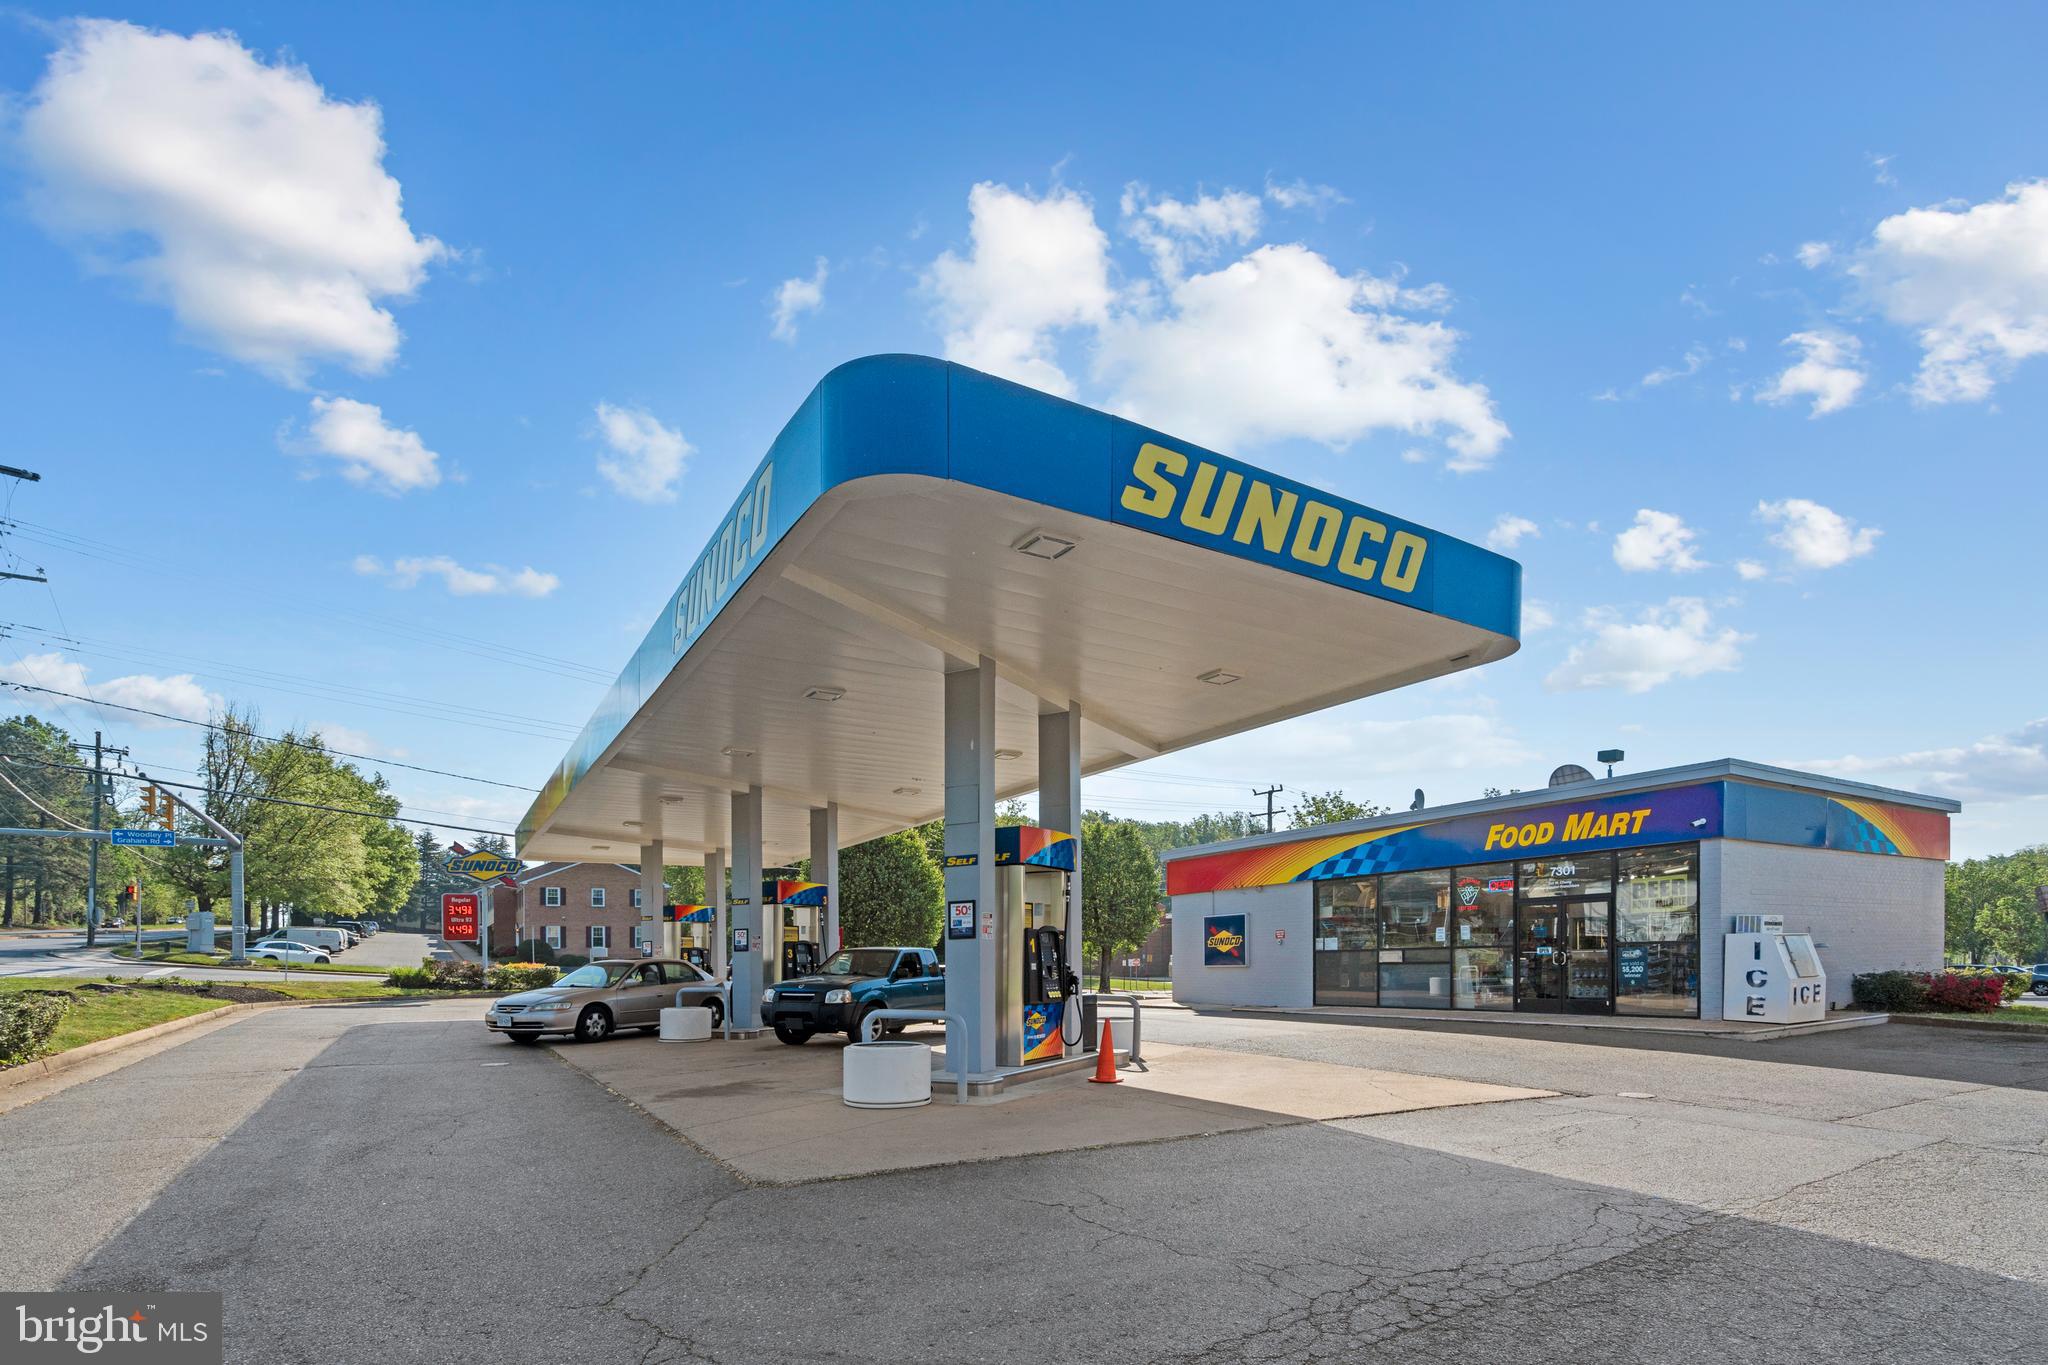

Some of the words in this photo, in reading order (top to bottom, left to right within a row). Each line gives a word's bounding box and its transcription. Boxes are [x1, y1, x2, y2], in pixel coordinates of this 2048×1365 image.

[1120, 442, 1428, 593] SUNOCO
[673, 461, 774, 655] SUNOCO
[1484, 822, 1555, 851] FOOD
[1562, 809, 1652, 842] MART
[450, 861, 518, 871] SUNOCO
[1550, 866, 1575, 876] 7301
[823, 896, 828, 905] 3
[1029, 938, 1035, 953] 1
[1209, 937, 1240, 946] SUNOCO
[788, 949, 793, 959] 3
[1746, 941, 1768, 1016] ICE
[1793, 983, 1821, 1005] ICE
[1027, 1016, 1046, 1026] SUNOCO
